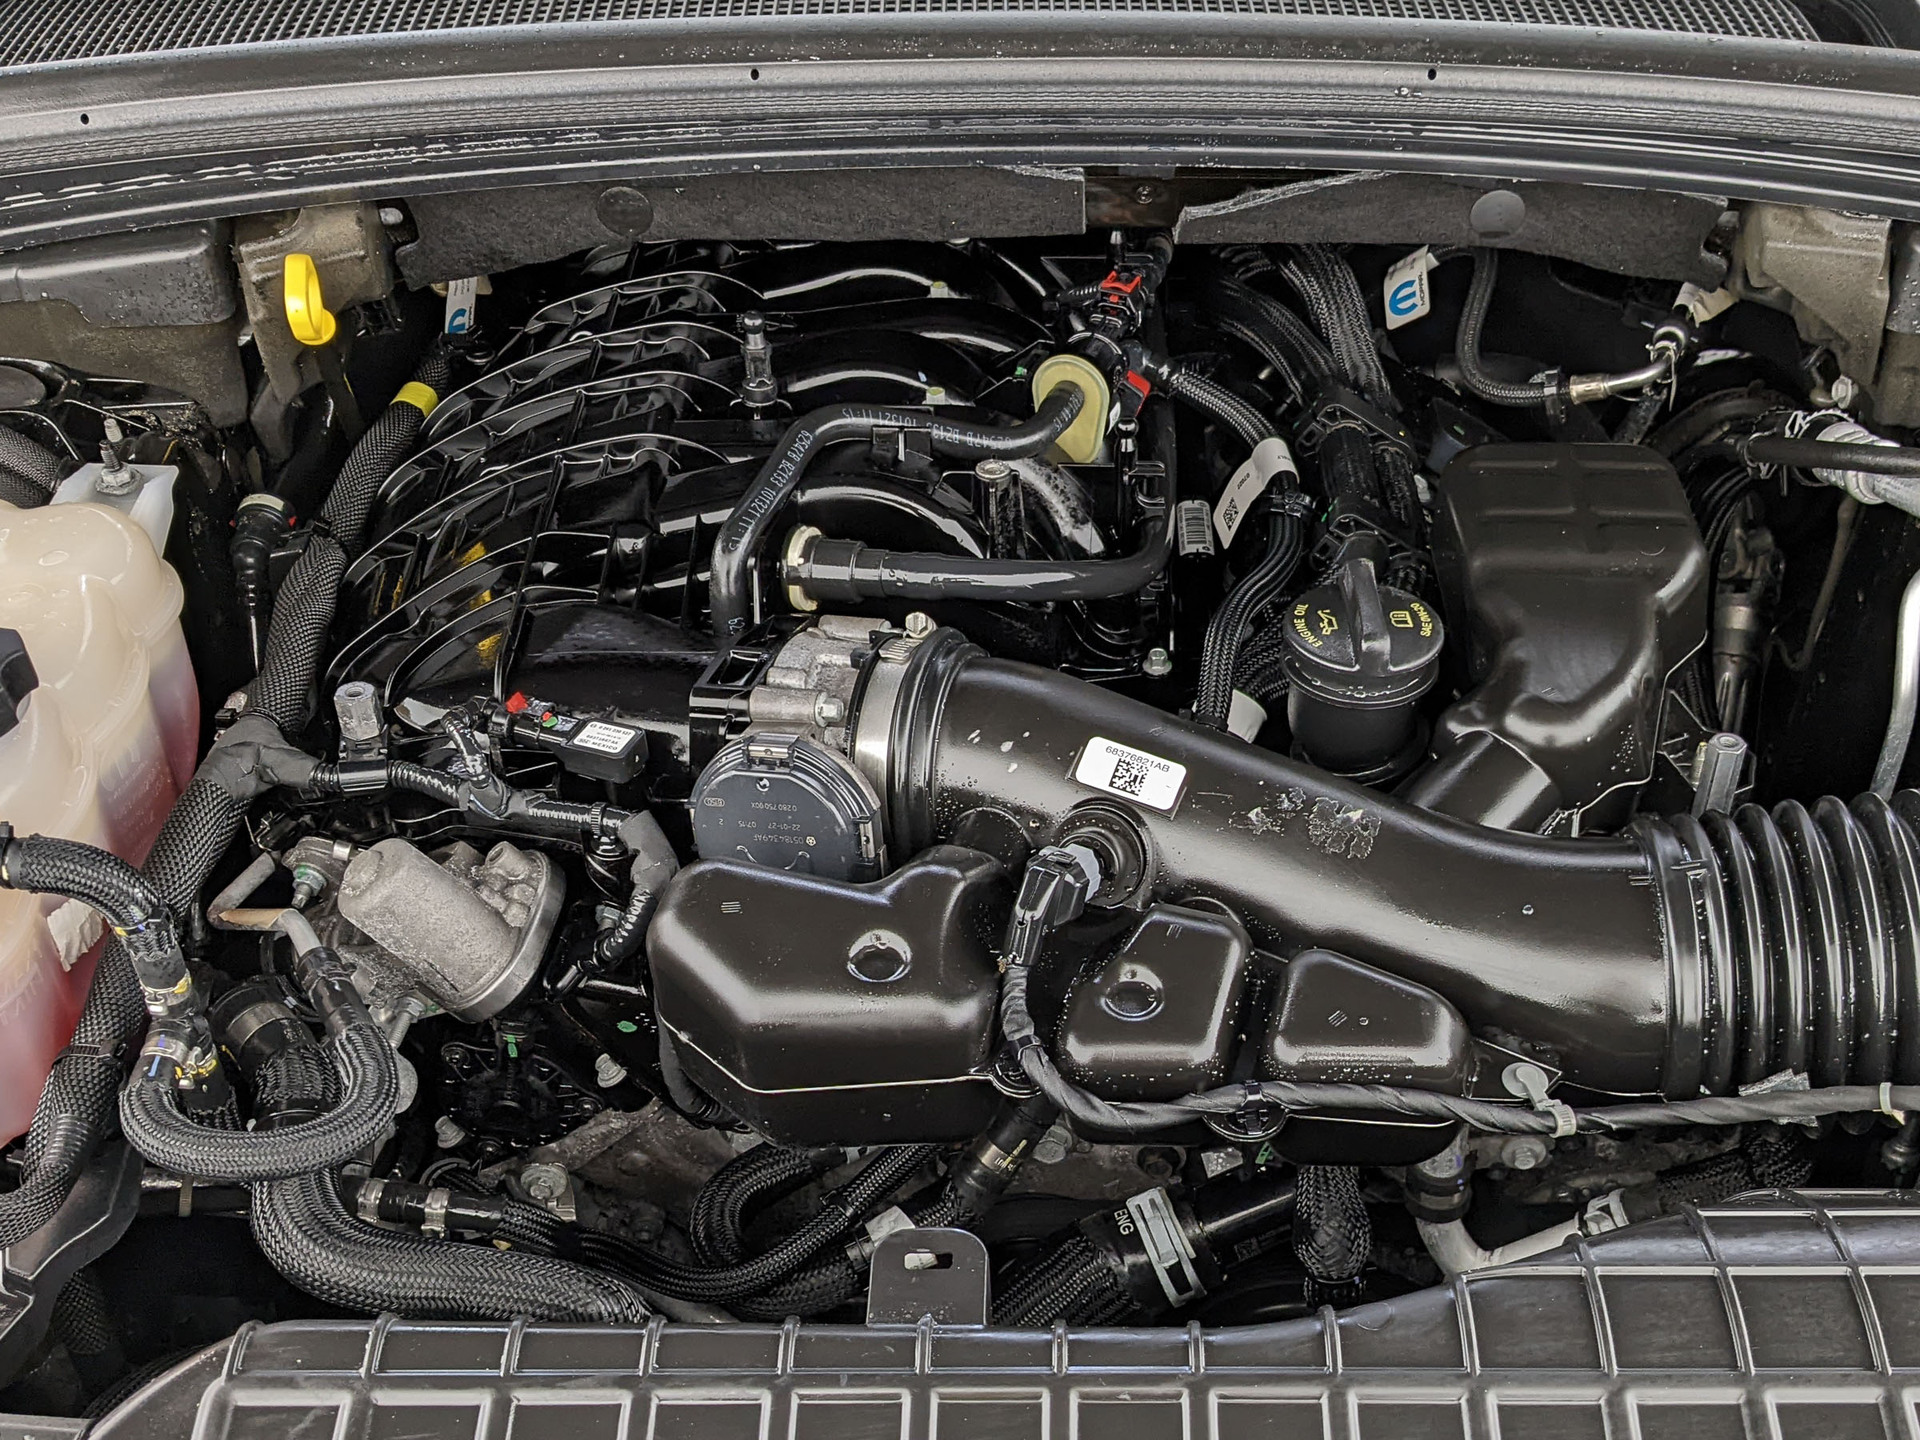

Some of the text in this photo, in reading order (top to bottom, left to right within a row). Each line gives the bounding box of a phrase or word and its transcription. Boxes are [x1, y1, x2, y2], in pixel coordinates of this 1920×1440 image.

[748, 486, 777, 518] 101321
[1294, 604, 1323, 648] ENGINE OIL
[1419, 622, 1433, 637] SAE
[591, 741, 618, 751] MEXICO
[1105, 745, 1170, 773] 68376821AB
[768, 822, 801, 832] 22-01-27
[1113, 1208, 1135, 1236] ENG
